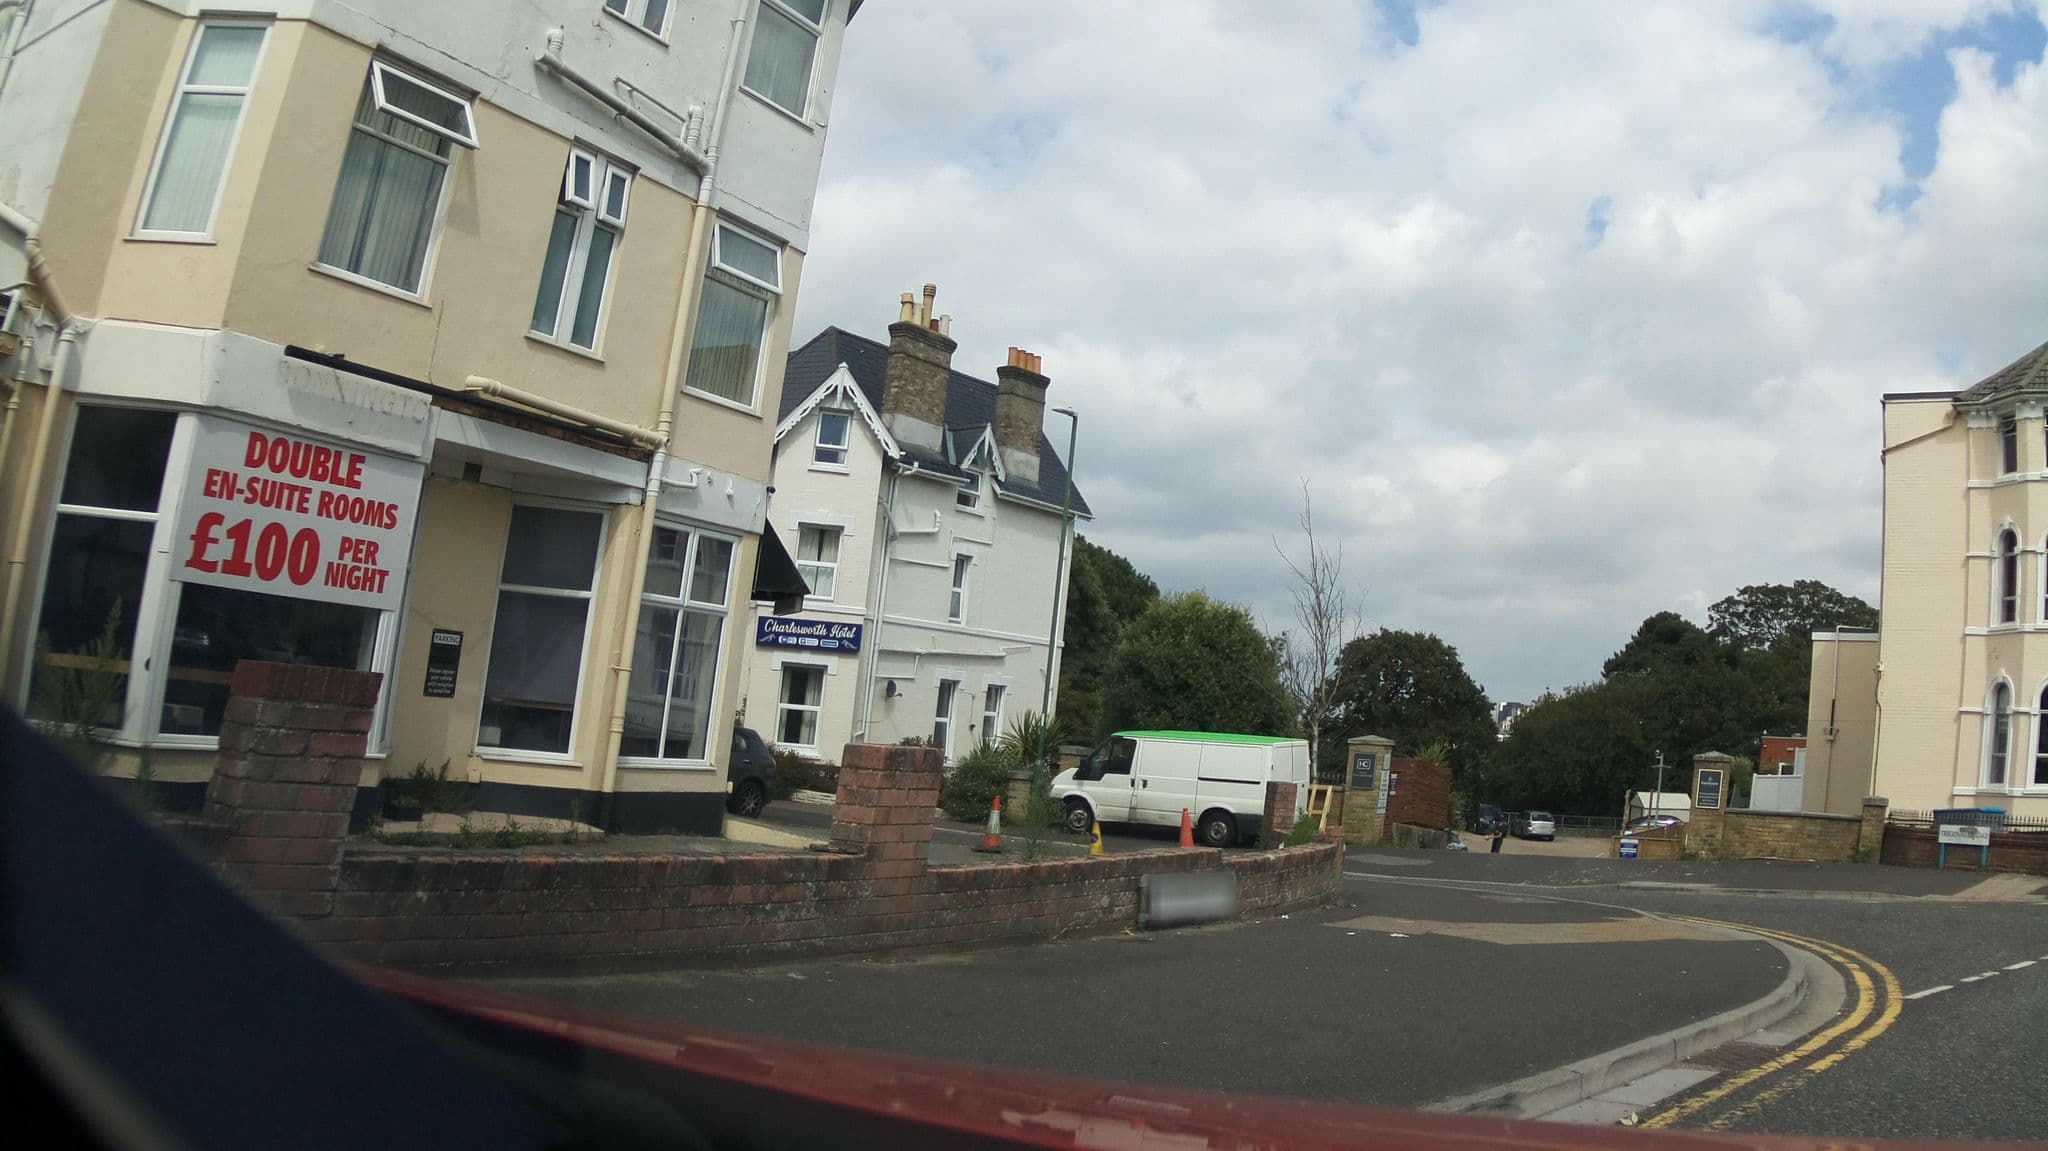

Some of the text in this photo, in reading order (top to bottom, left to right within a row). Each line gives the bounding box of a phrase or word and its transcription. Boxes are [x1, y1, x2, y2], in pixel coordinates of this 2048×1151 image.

[244, 431, 366, 490] DOUBLE
[203, 468, 399, 530] EN-SUITE ROOMS
[184, 511, 321, 586] £100
[338, 536, 380, 566] PER
[324, 562, 390, 594] NIGHT
[435, 634, 461, 644] PARKING
[764, 619, 857, 639] Charlesworth Hotel
